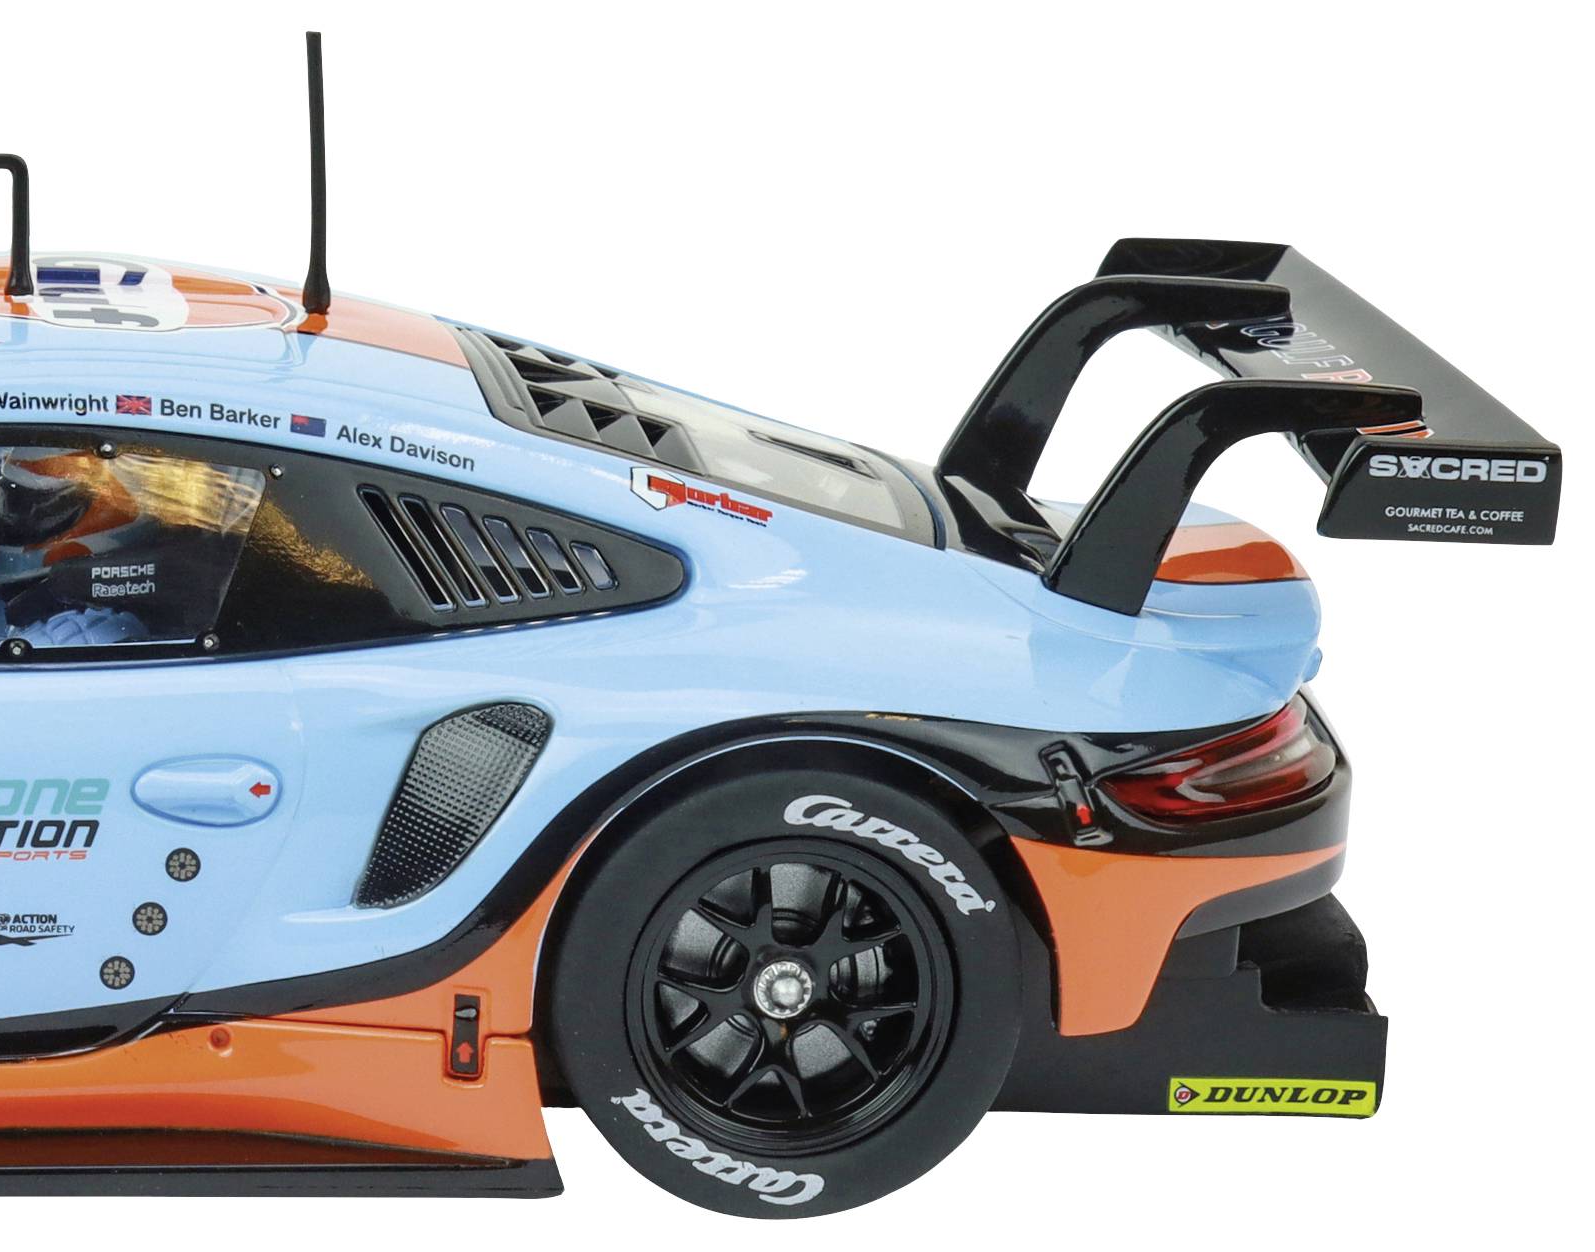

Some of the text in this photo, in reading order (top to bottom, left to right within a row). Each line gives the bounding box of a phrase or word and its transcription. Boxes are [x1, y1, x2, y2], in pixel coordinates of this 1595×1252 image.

[160, 398, 281, 429] Ben Barker
[336, 424, 475, 472] Alex Davison
[1384, 506, 1524, 522] GOURMET TEA & COFFEE
[1407, 523, 1494, 536] SACREDCAFE.COM
[91, 564, 155, 579] PORSCHE
[12, 914, 57, 924] ACTION
[9, 924, 36, 934] ROAD
[38, 925, 75, 933] SAFETY
[1203, 1086, 1368, 1105] DUNLOP
